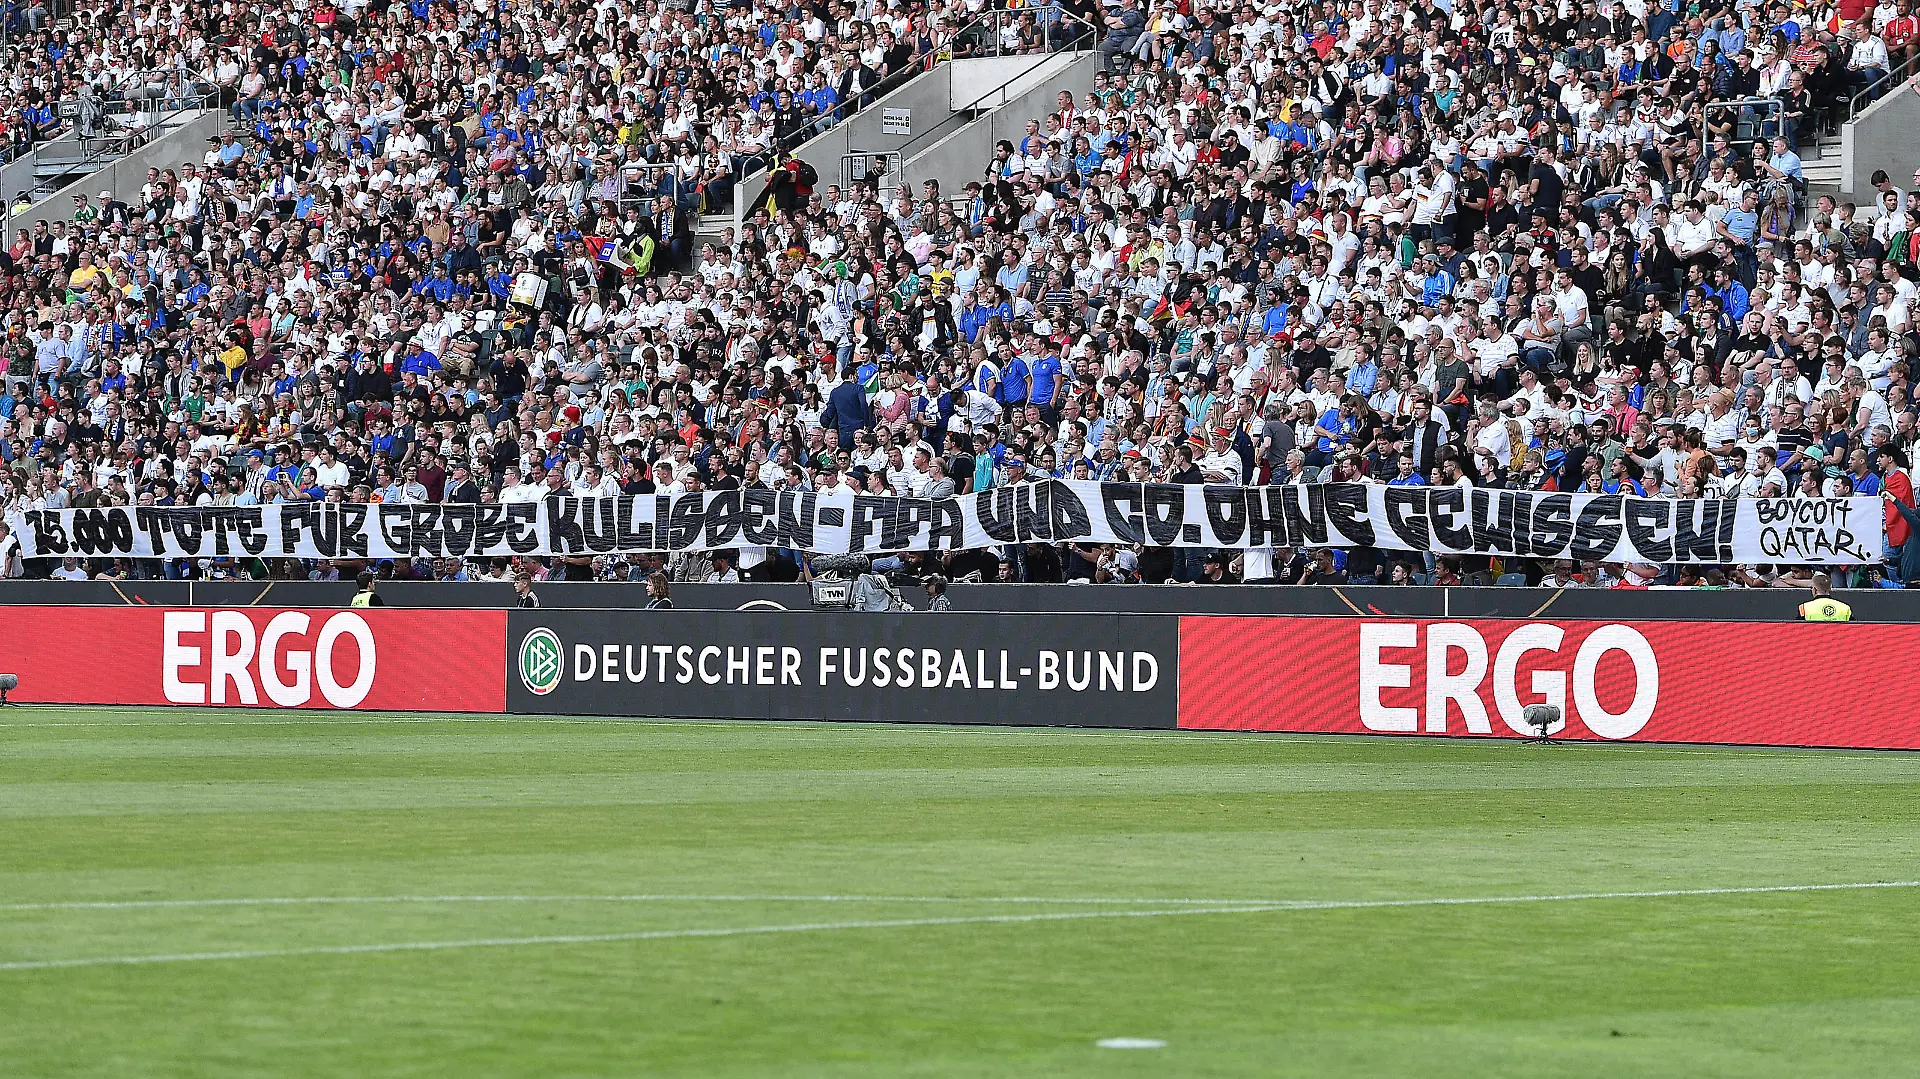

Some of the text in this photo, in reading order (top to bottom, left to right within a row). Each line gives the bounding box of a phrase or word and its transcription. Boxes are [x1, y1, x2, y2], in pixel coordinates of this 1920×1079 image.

[24, 508, 134, 556] 15.000
[135, 506, 268, 556] TOTE
[281, 502, 368, 557] FÜR
[976, 479, 1092, 543] UND
[1100, 482, 1201, 546] CO.
[1203, 483, 1376, 546] OHNE
[1384, 487, 1737, 563] GEWISSEN!
[1760, 527, 1872, 561] QATAR.
[827, 590, 844, 598] TVN
[162, 610, 377, 709] ERGO
[574, 643, 1160, 694] DEUTSCHER FUSSBALL-BUND
[1358, 622, 1659, 740] ERGO
